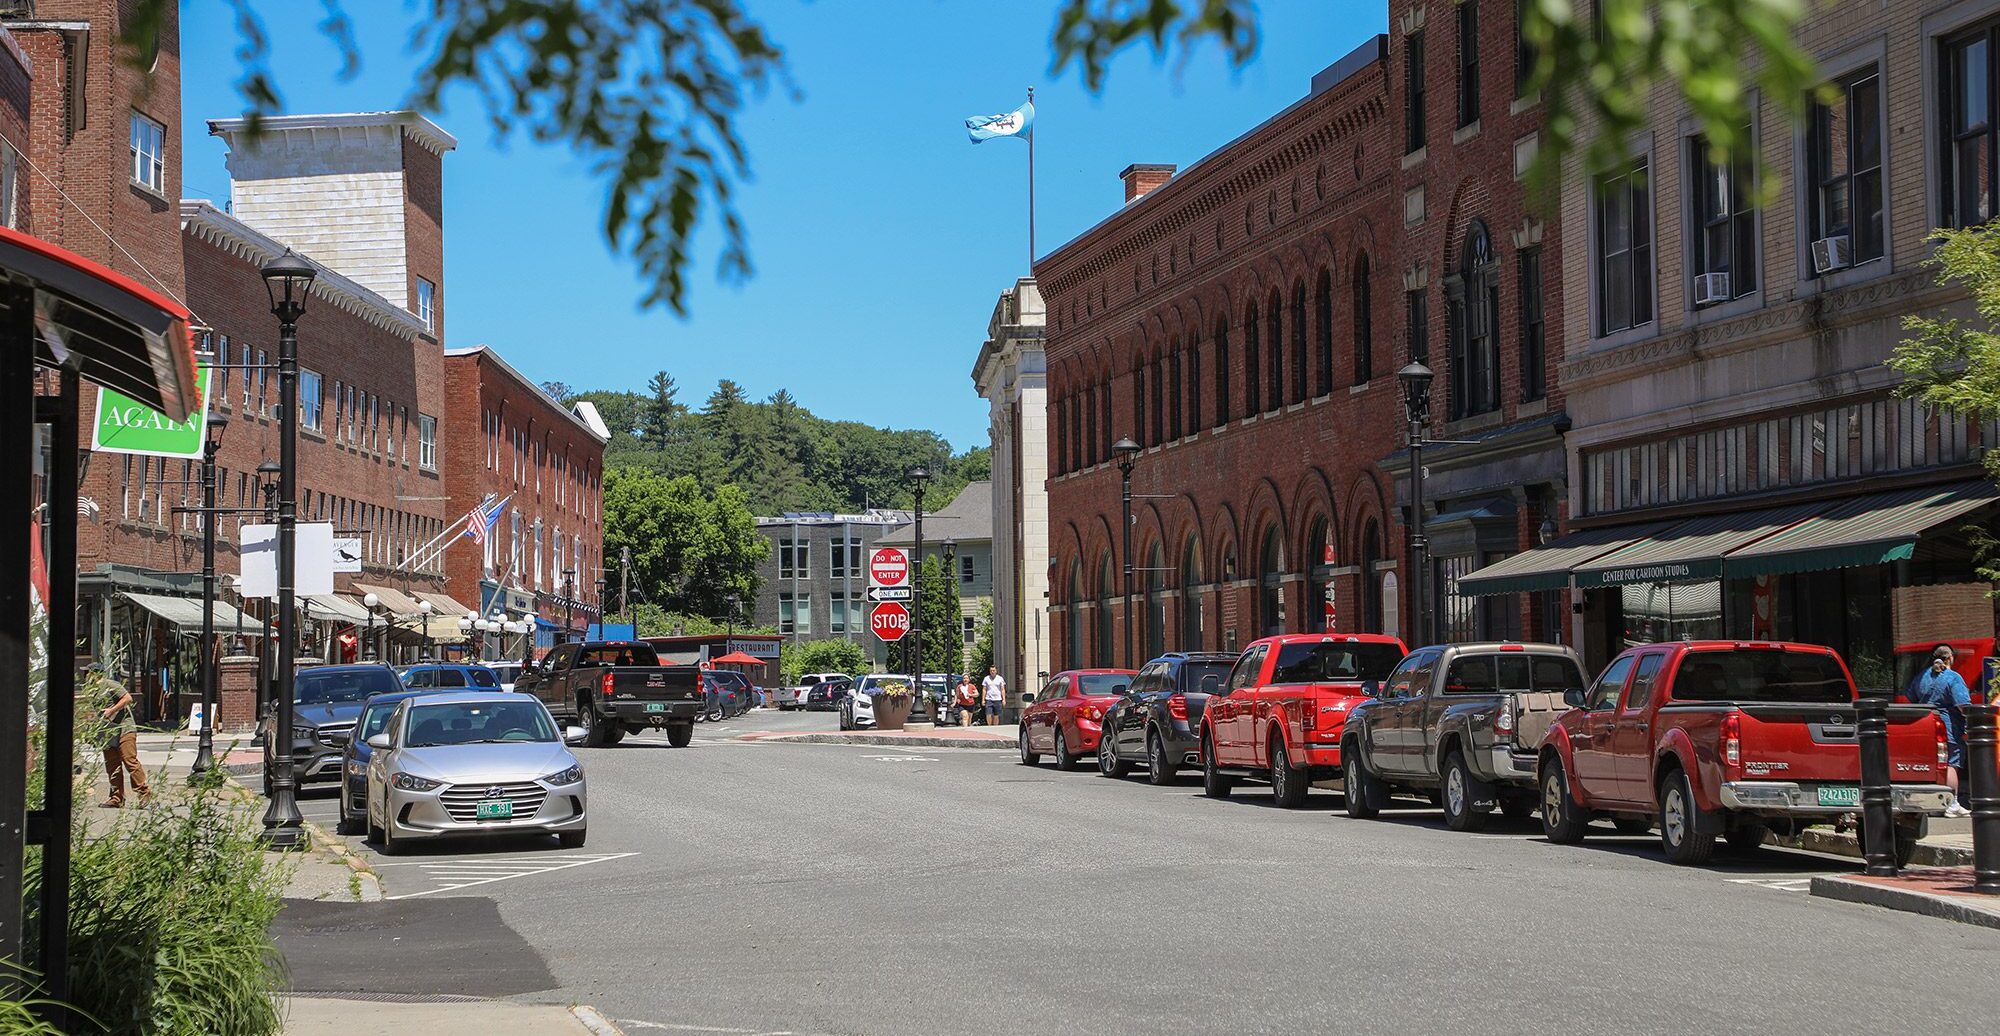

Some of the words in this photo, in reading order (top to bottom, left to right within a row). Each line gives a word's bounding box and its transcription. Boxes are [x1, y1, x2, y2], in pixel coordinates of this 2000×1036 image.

[103, 405, 199, 432] AGAIN
[875, 554, 886, 562] DO
[890, 554, 902, 562] NOT
[878, 571, 900, 579] ENTER
[1602, 570, 1624, 582] CENTER
[1624, 568, 1636, 581] FOR
[1635, 566, 1664, 580] CARTOON
[1664, 564, 1689, 577] STUDIES
[893, 590, 908, 598] WAY
[873, 613, 907, 629] STOP
[1744, 761, 1790, 770] FRONTIER
[1896, 763, 1911, 772] SV
